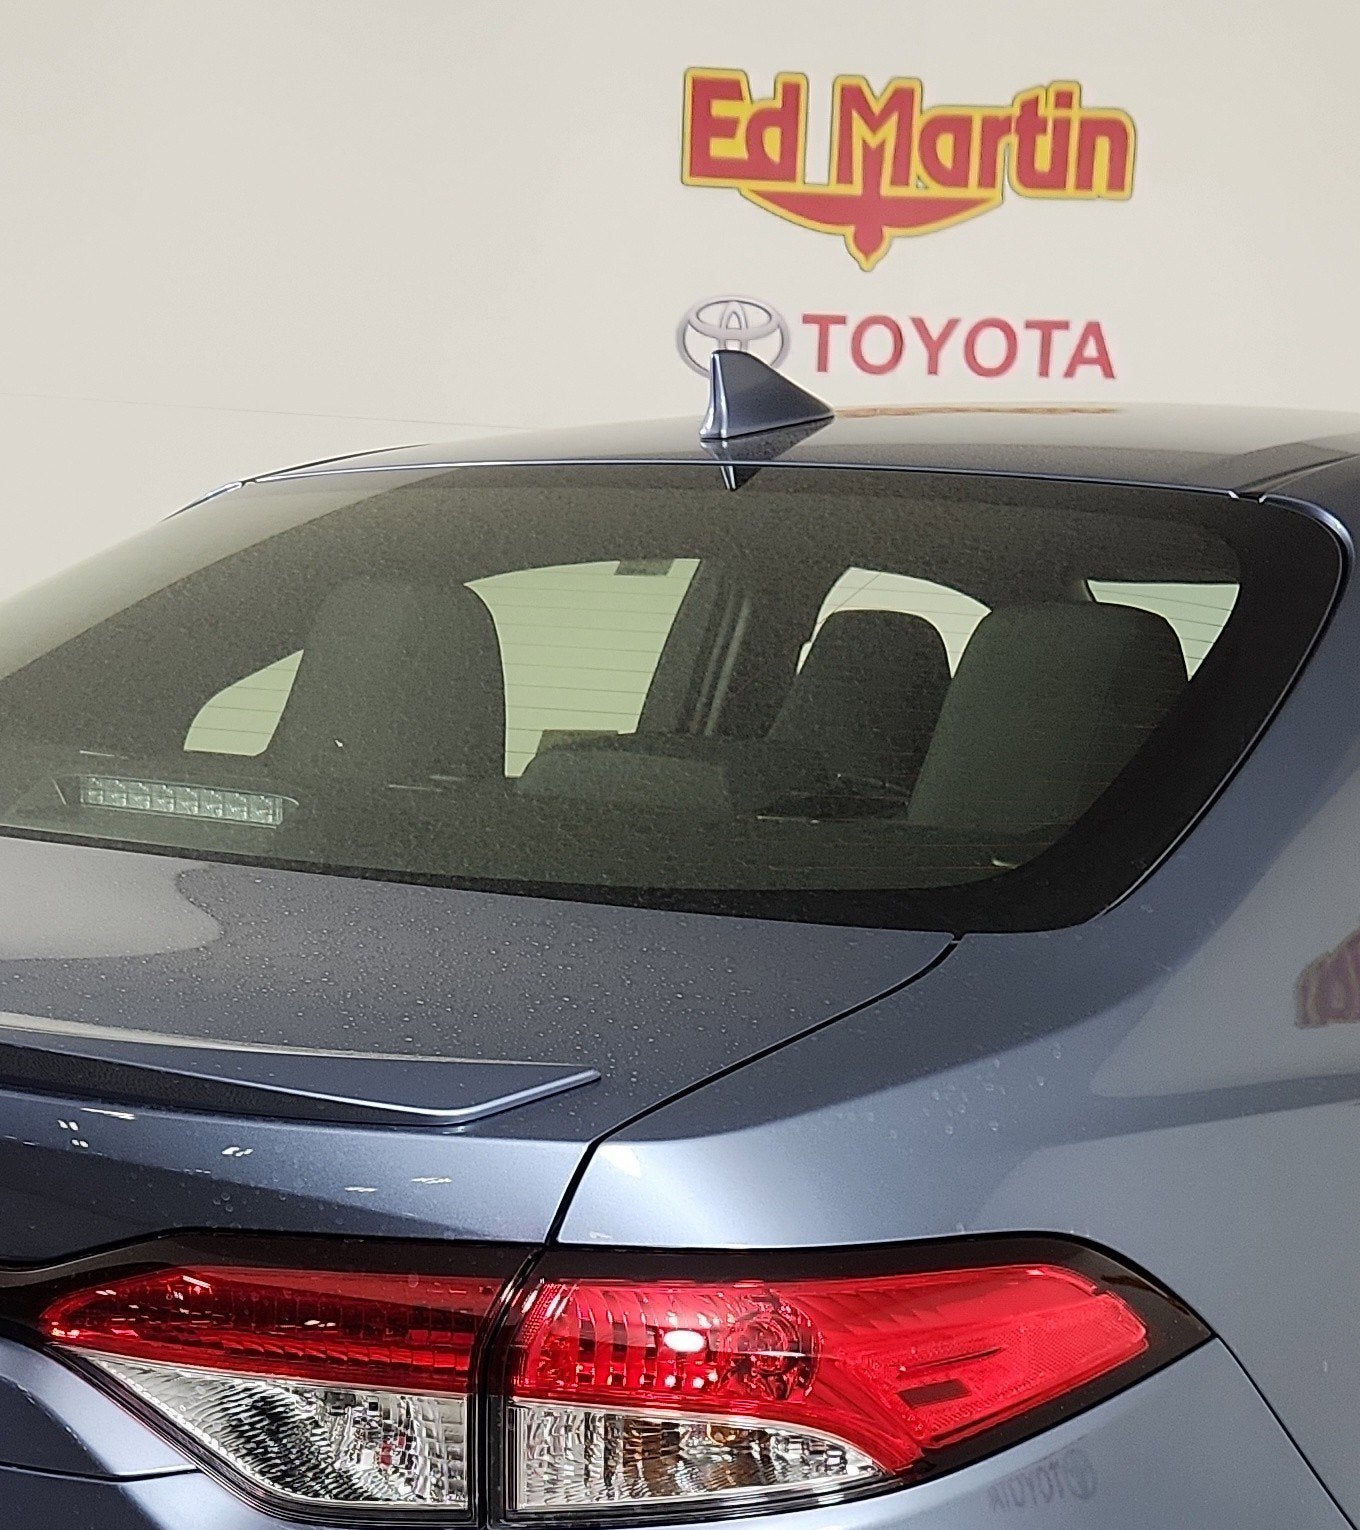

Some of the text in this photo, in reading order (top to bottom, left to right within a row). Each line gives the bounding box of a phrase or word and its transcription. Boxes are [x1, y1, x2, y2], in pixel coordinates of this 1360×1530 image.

[686, 70, 1134, 198] Ed Martin
[802, 313, 1116, 379] TOYOTA
